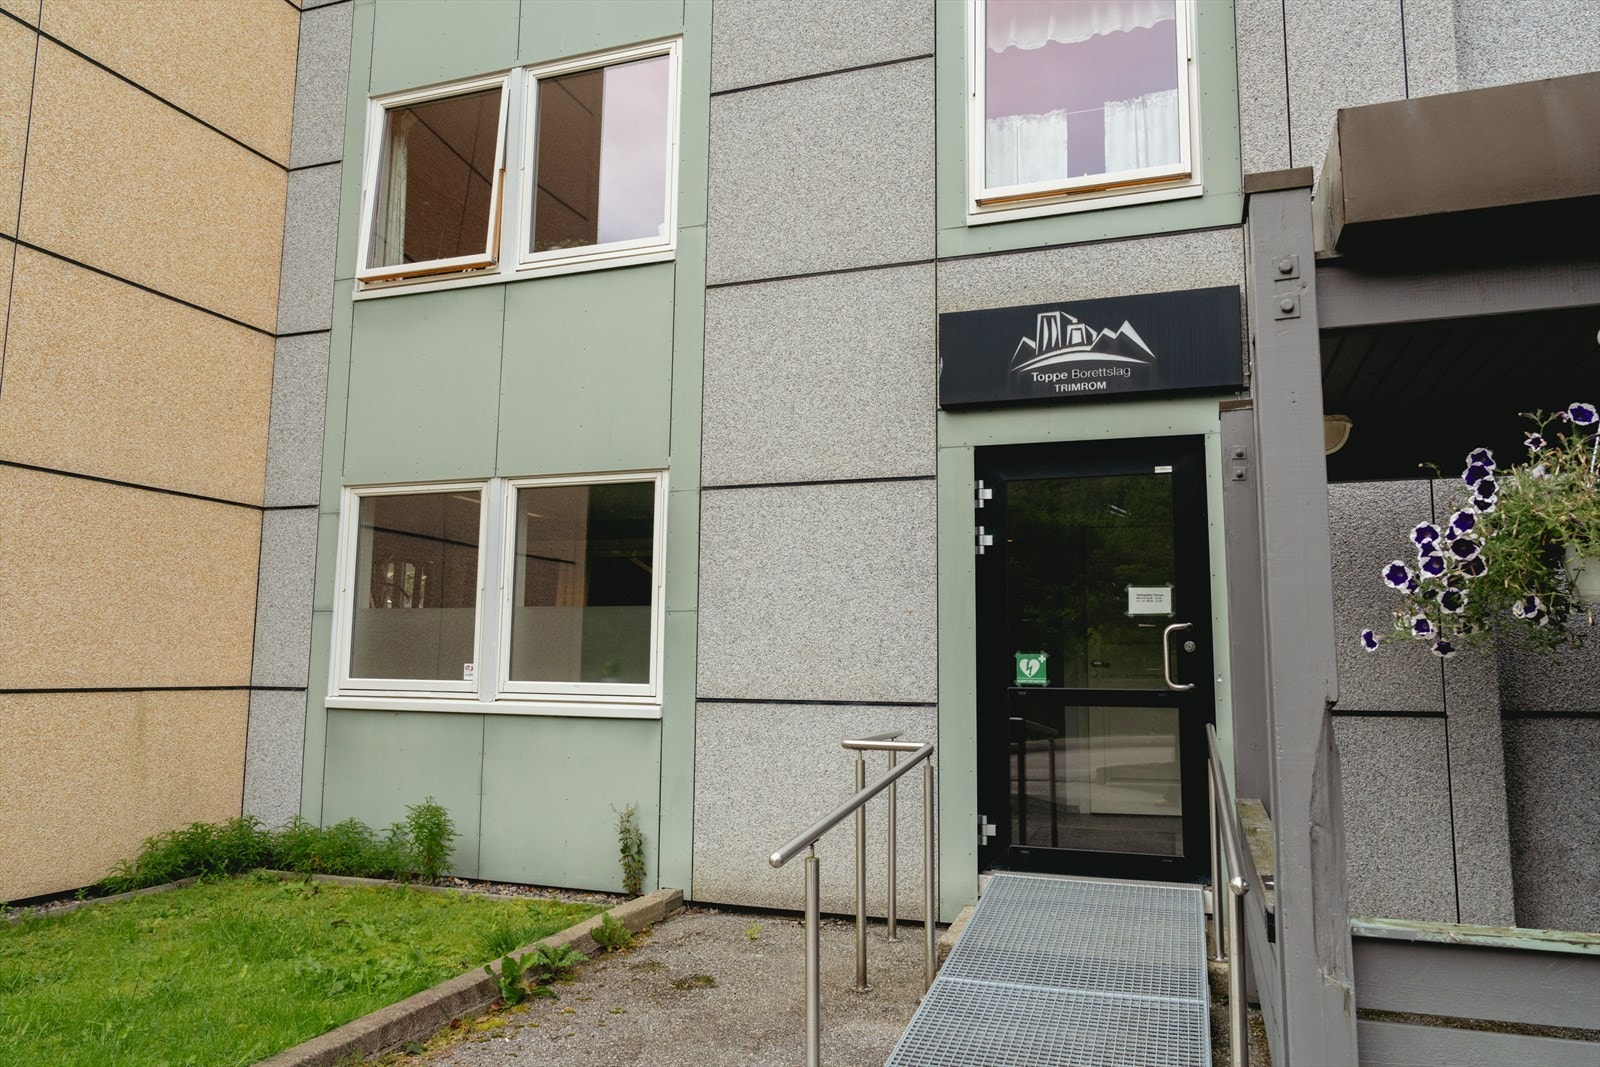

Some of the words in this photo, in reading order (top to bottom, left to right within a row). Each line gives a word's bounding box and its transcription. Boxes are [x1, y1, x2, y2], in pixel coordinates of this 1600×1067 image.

[1031, 371, 1068, 383] Toppe
[1071, 366, 1131, 378] Borettslag
[1054, 381, 1107, 393] TRIMROM
